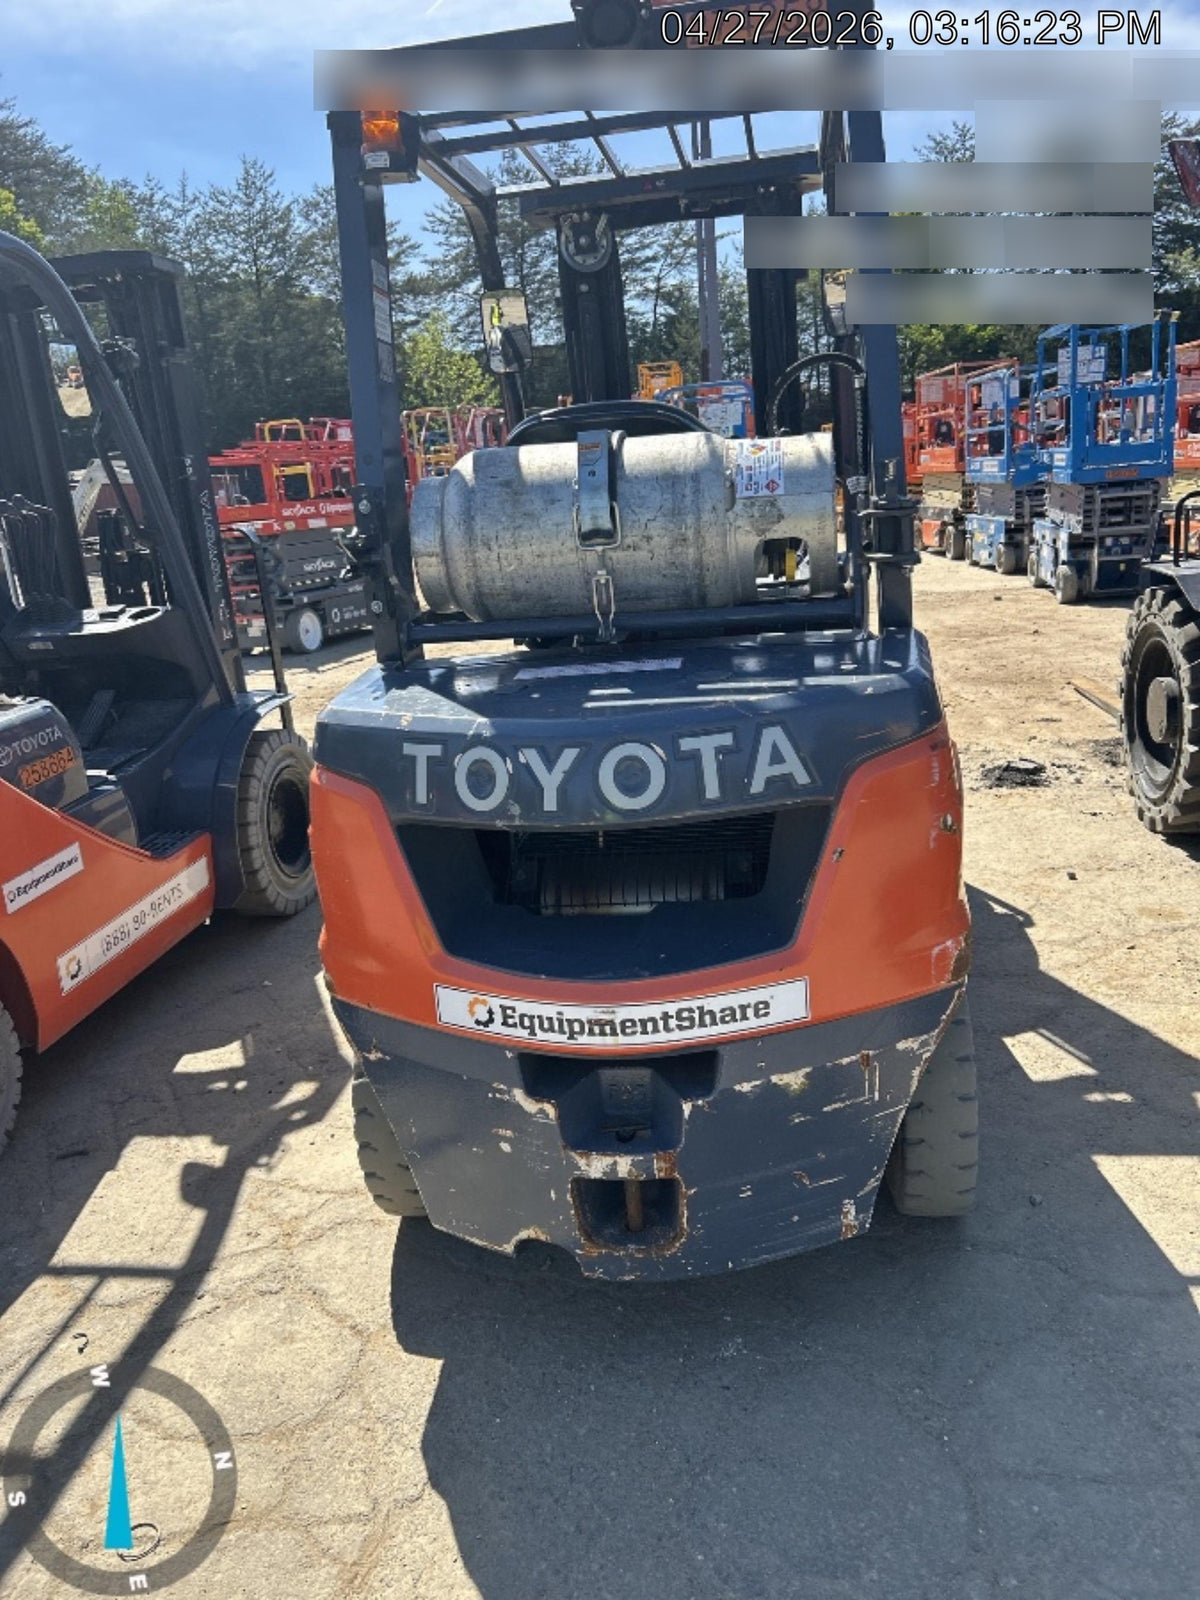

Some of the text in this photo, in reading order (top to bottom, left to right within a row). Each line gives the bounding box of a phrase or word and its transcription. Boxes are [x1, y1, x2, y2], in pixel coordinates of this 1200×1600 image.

[11, 724, 63, 757] TOYOTA
[403, 726, 811, 812] TOYOTA
[499, 1000, 771, 1040] EquipmentShare
